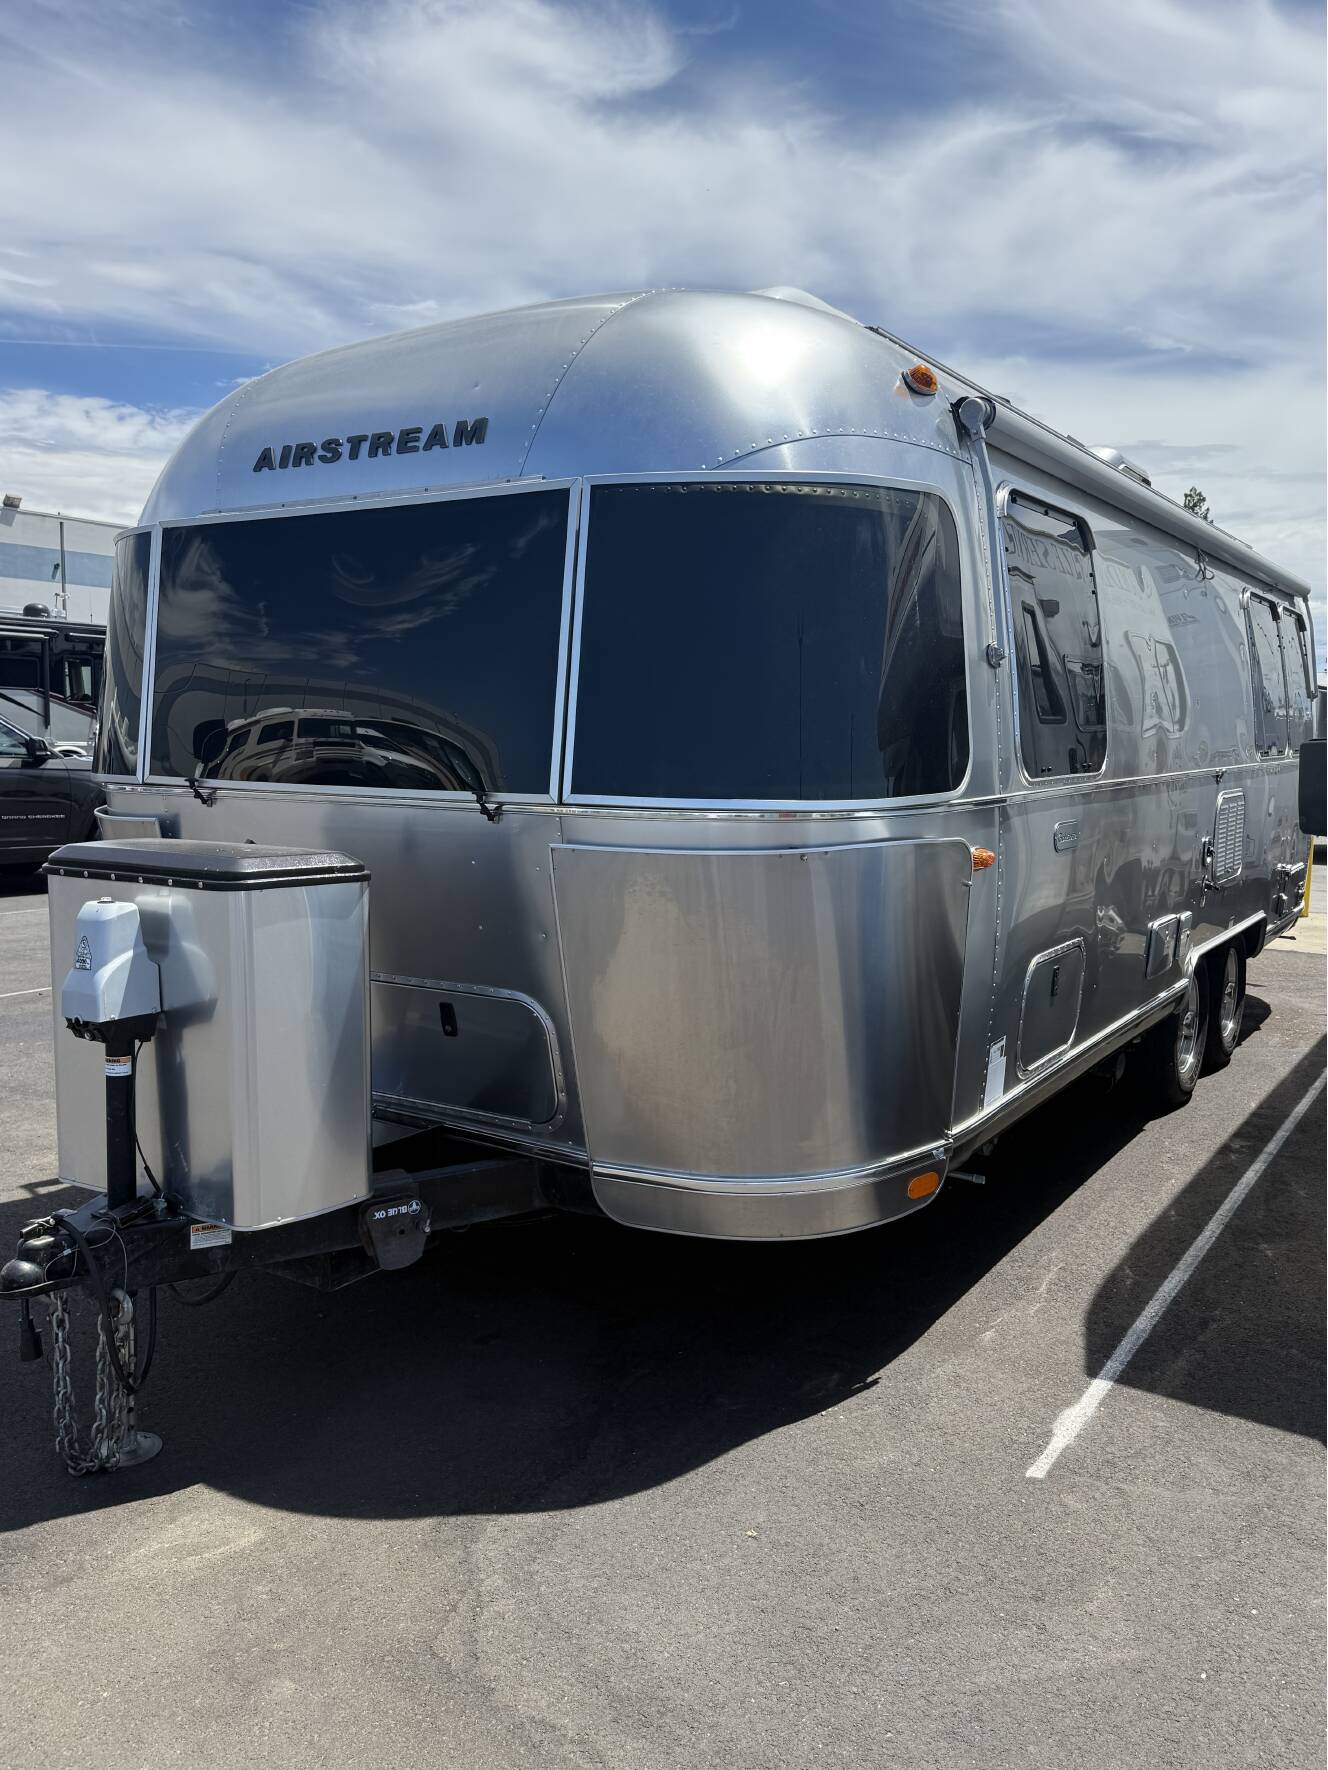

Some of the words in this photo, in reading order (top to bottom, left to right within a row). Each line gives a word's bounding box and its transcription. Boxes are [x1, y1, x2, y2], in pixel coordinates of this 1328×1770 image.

[253, 416, 489, 473] AIRSTREAM
[372, 1210, 387, 1220] OX
[387, 1205, 408, 1217] BLUE
